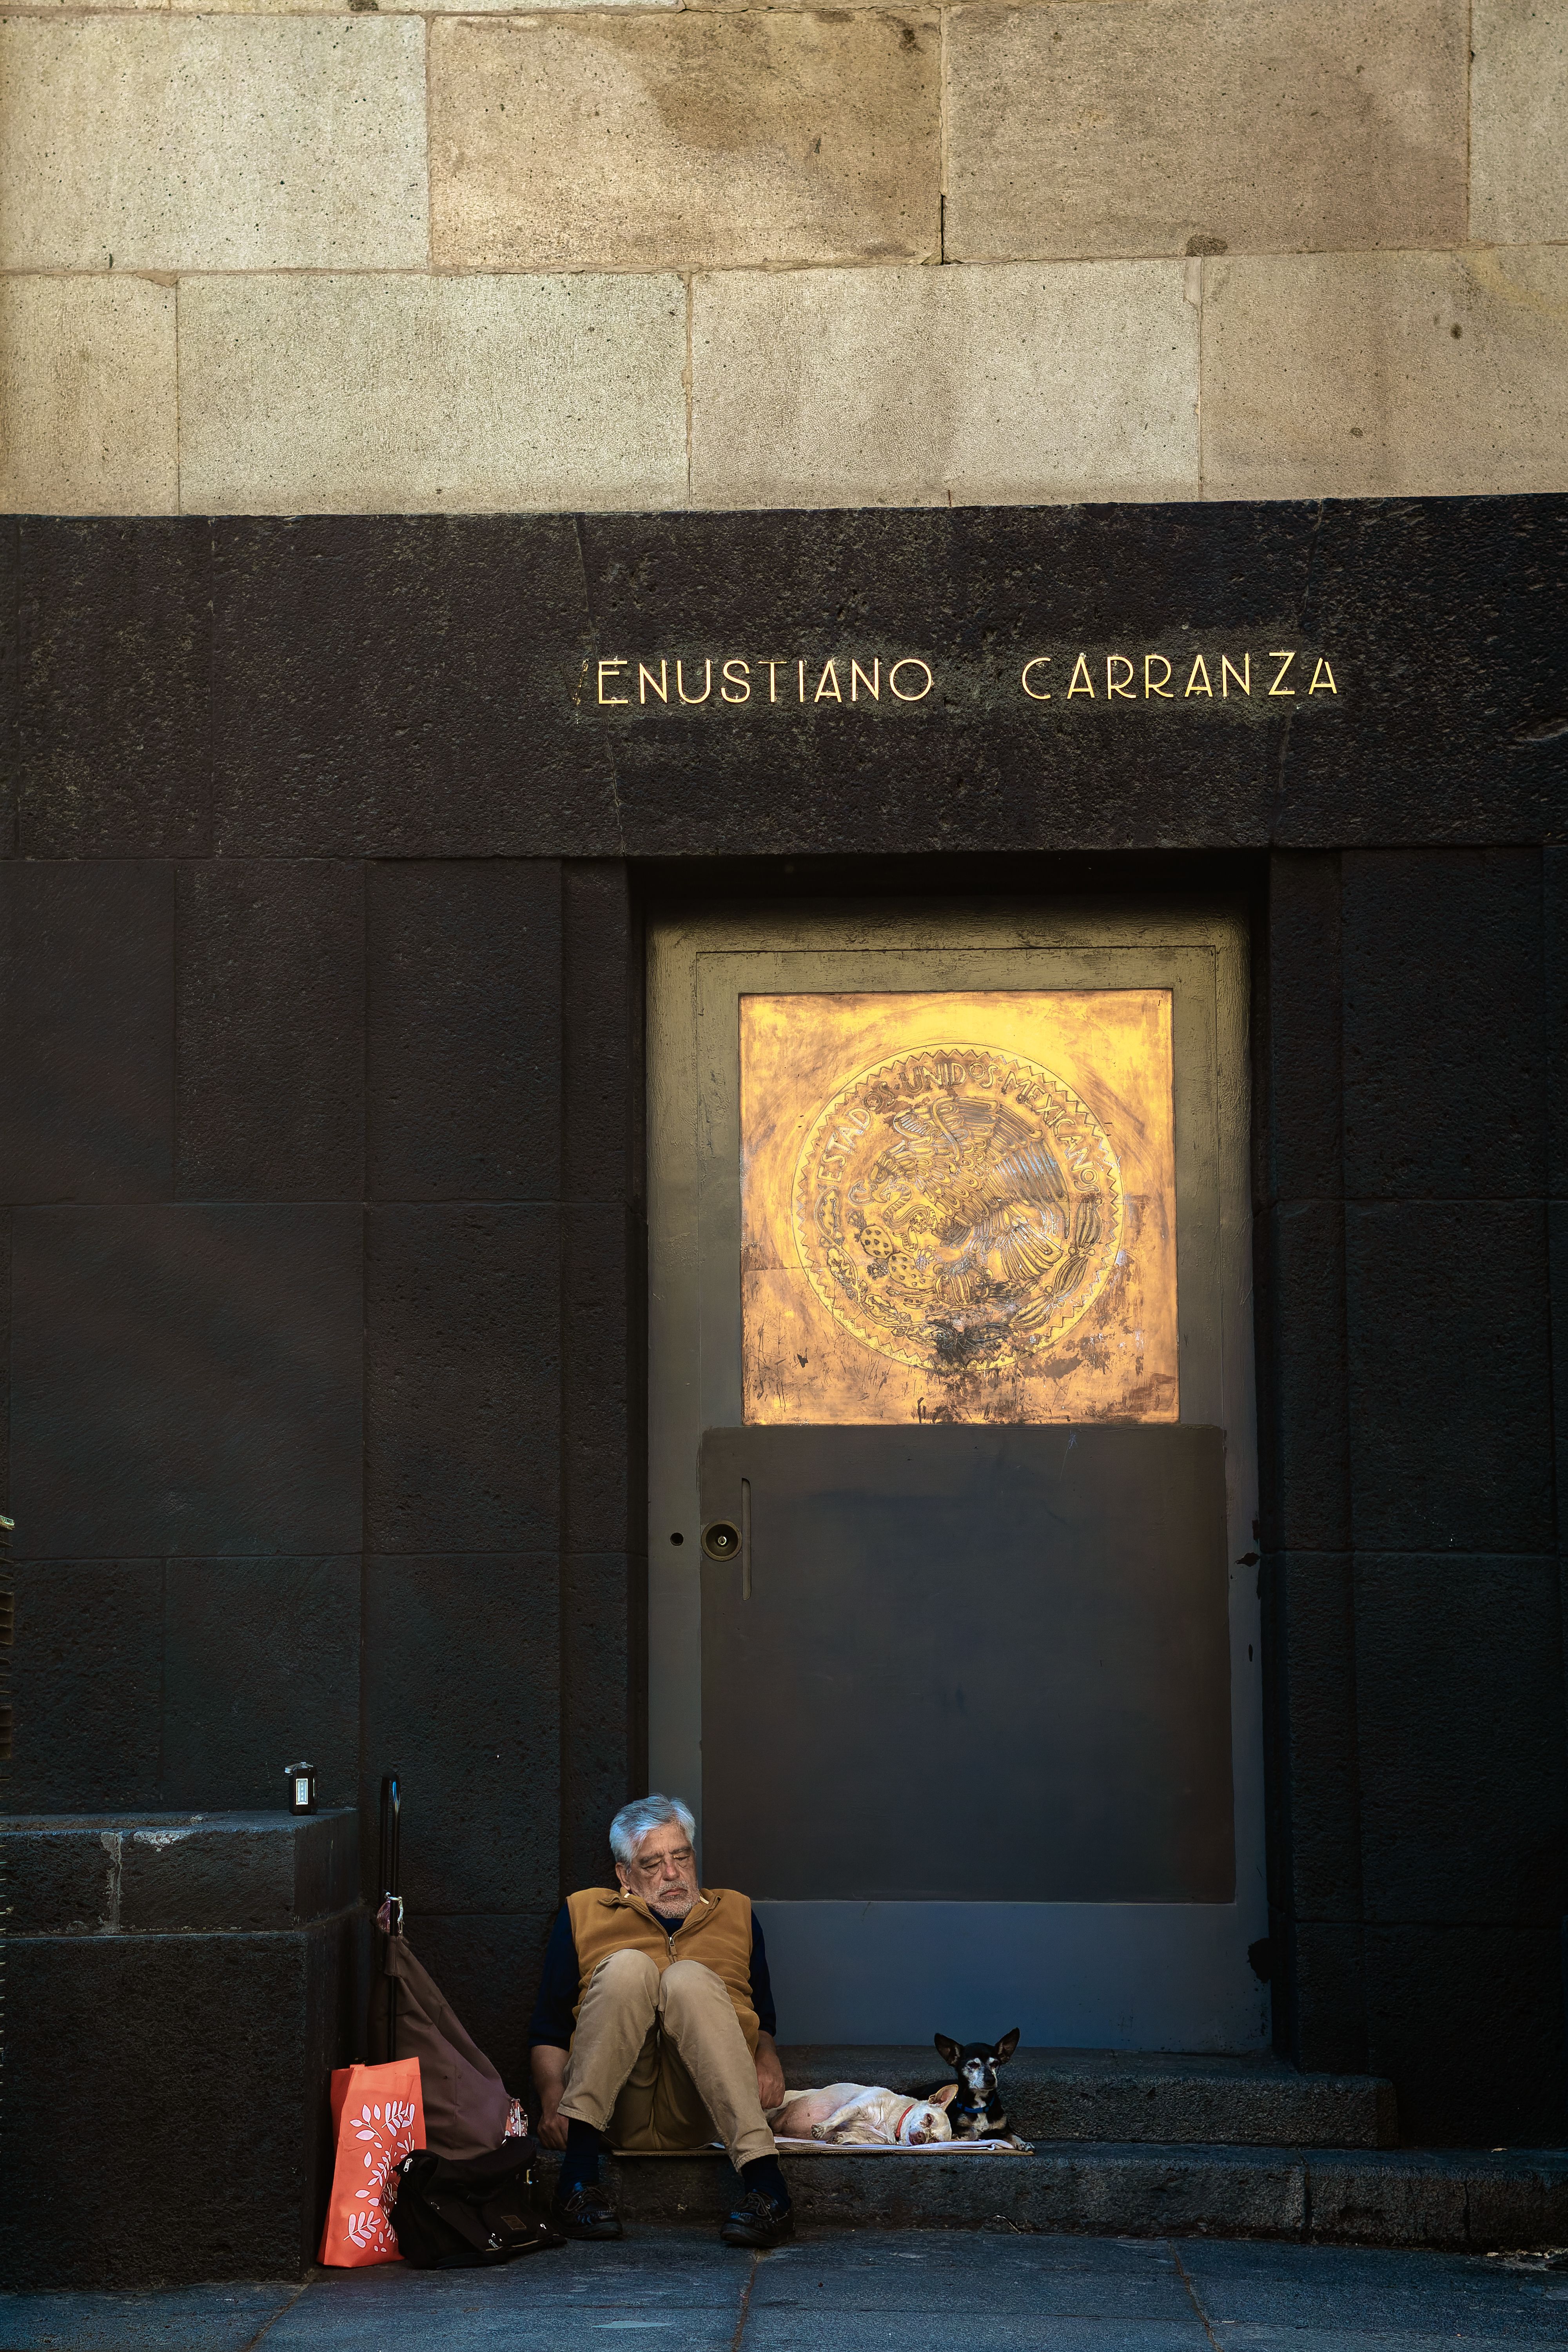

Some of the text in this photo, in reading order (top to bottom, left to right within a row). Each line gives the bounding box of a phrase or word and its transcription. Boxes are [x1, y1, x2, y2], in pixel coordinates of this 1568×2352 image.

[1022, 652, 1337, 699] CARRANZA
[817, 1062, 1100, 1192] ESTADOS UNIDOS MEXICANOS
